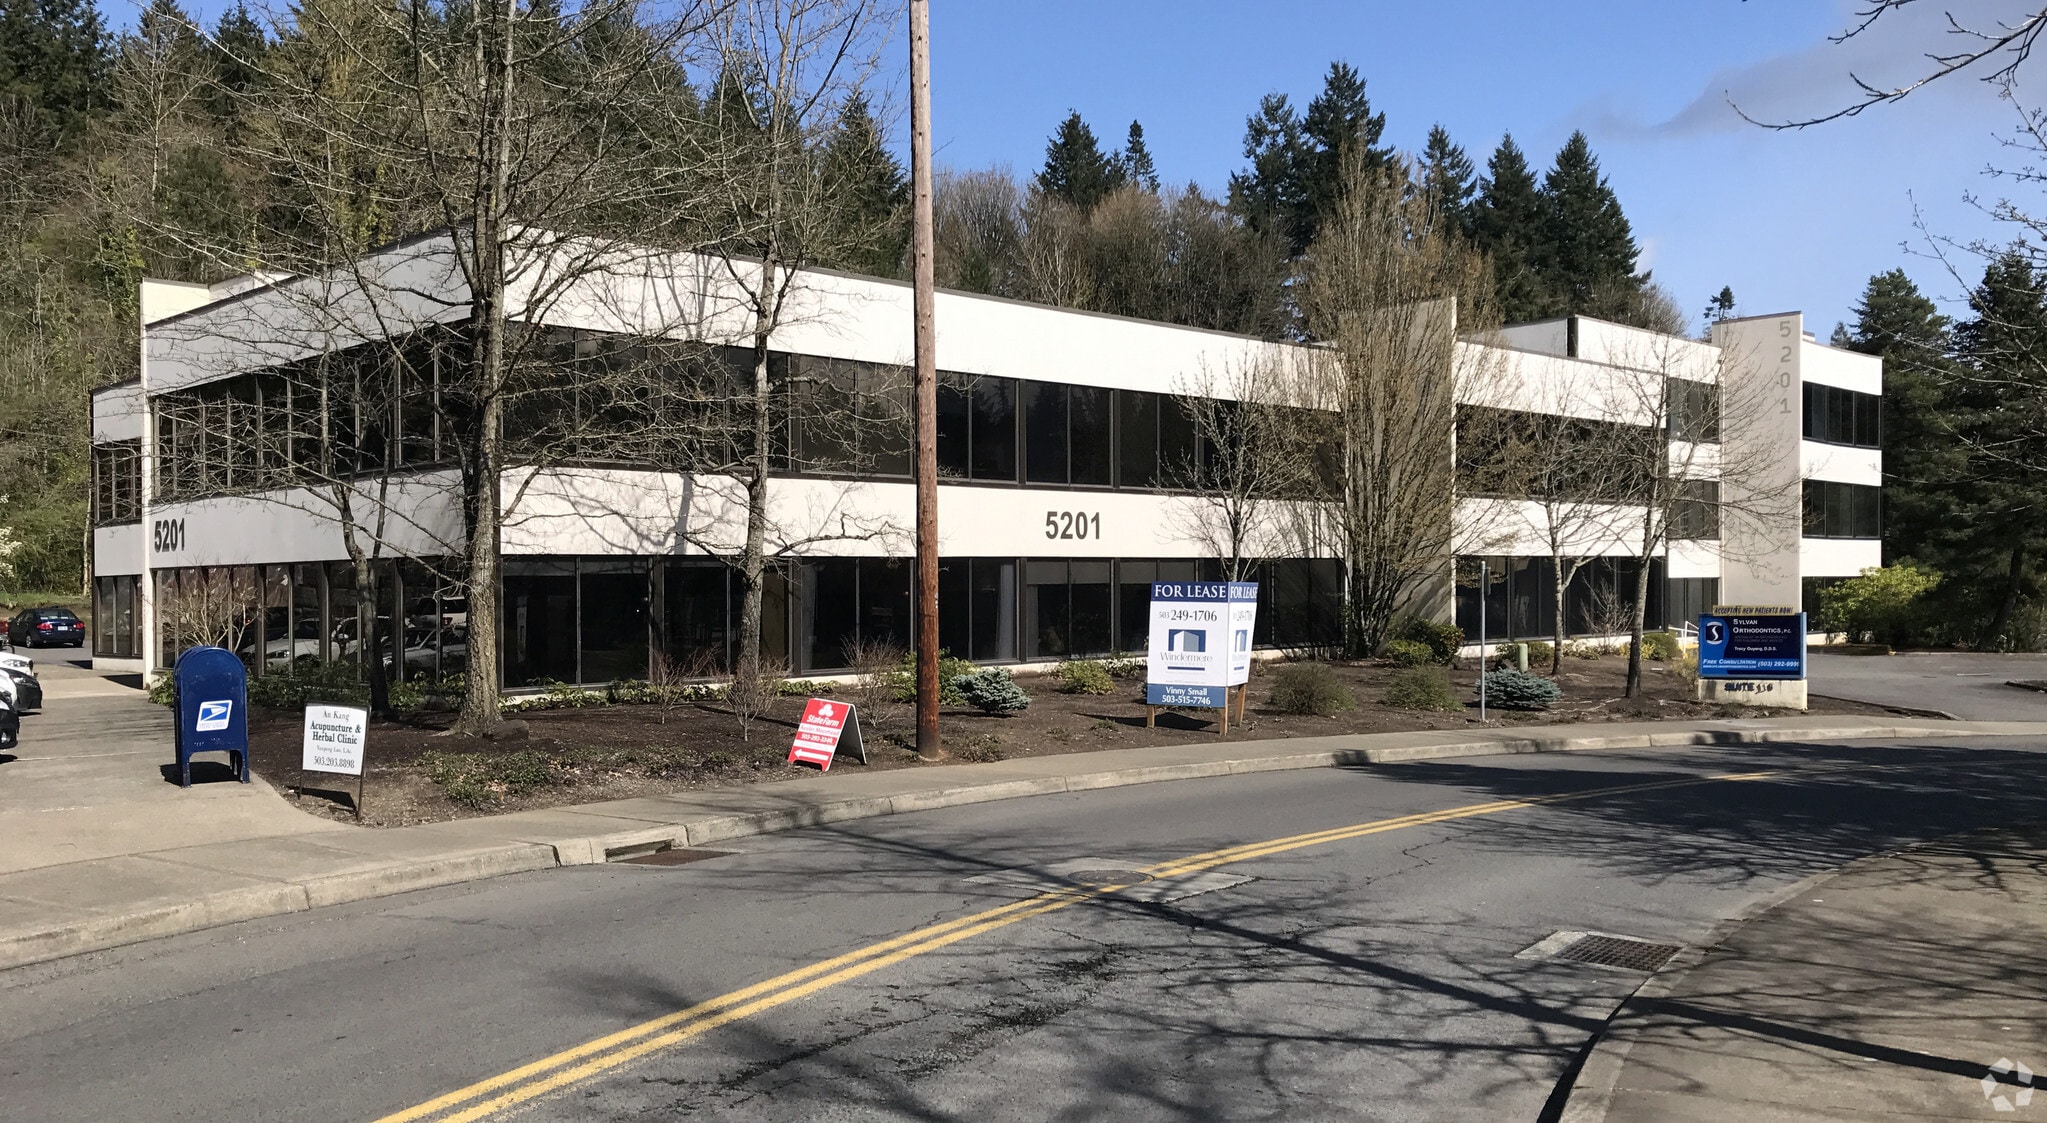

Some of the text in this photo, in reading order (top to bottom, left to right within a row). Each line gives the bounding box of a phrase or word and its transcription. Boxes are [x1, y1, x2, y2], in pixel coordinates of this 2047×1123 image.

[1779, 320, 1792, 414] 5201
[1045, 511, 1100, 540] 5201
[154, 518, 185, 553] 5201
[1154, 585, 1227, 598] FOR LEASE
[1230, 586, 1258, 599] FOR LEASE
[1170, 610, 1218, 622] 249-1706
[1160, 652, 1213, 662] Windermere
[1165, 687, 1208, 697] Vinny Small
[1162, 695, 1211, 705] 503-515-7746
[310, 720, 361, 734] Acupuncture &
[312, 731, 358, 744] Herbal Clinic
